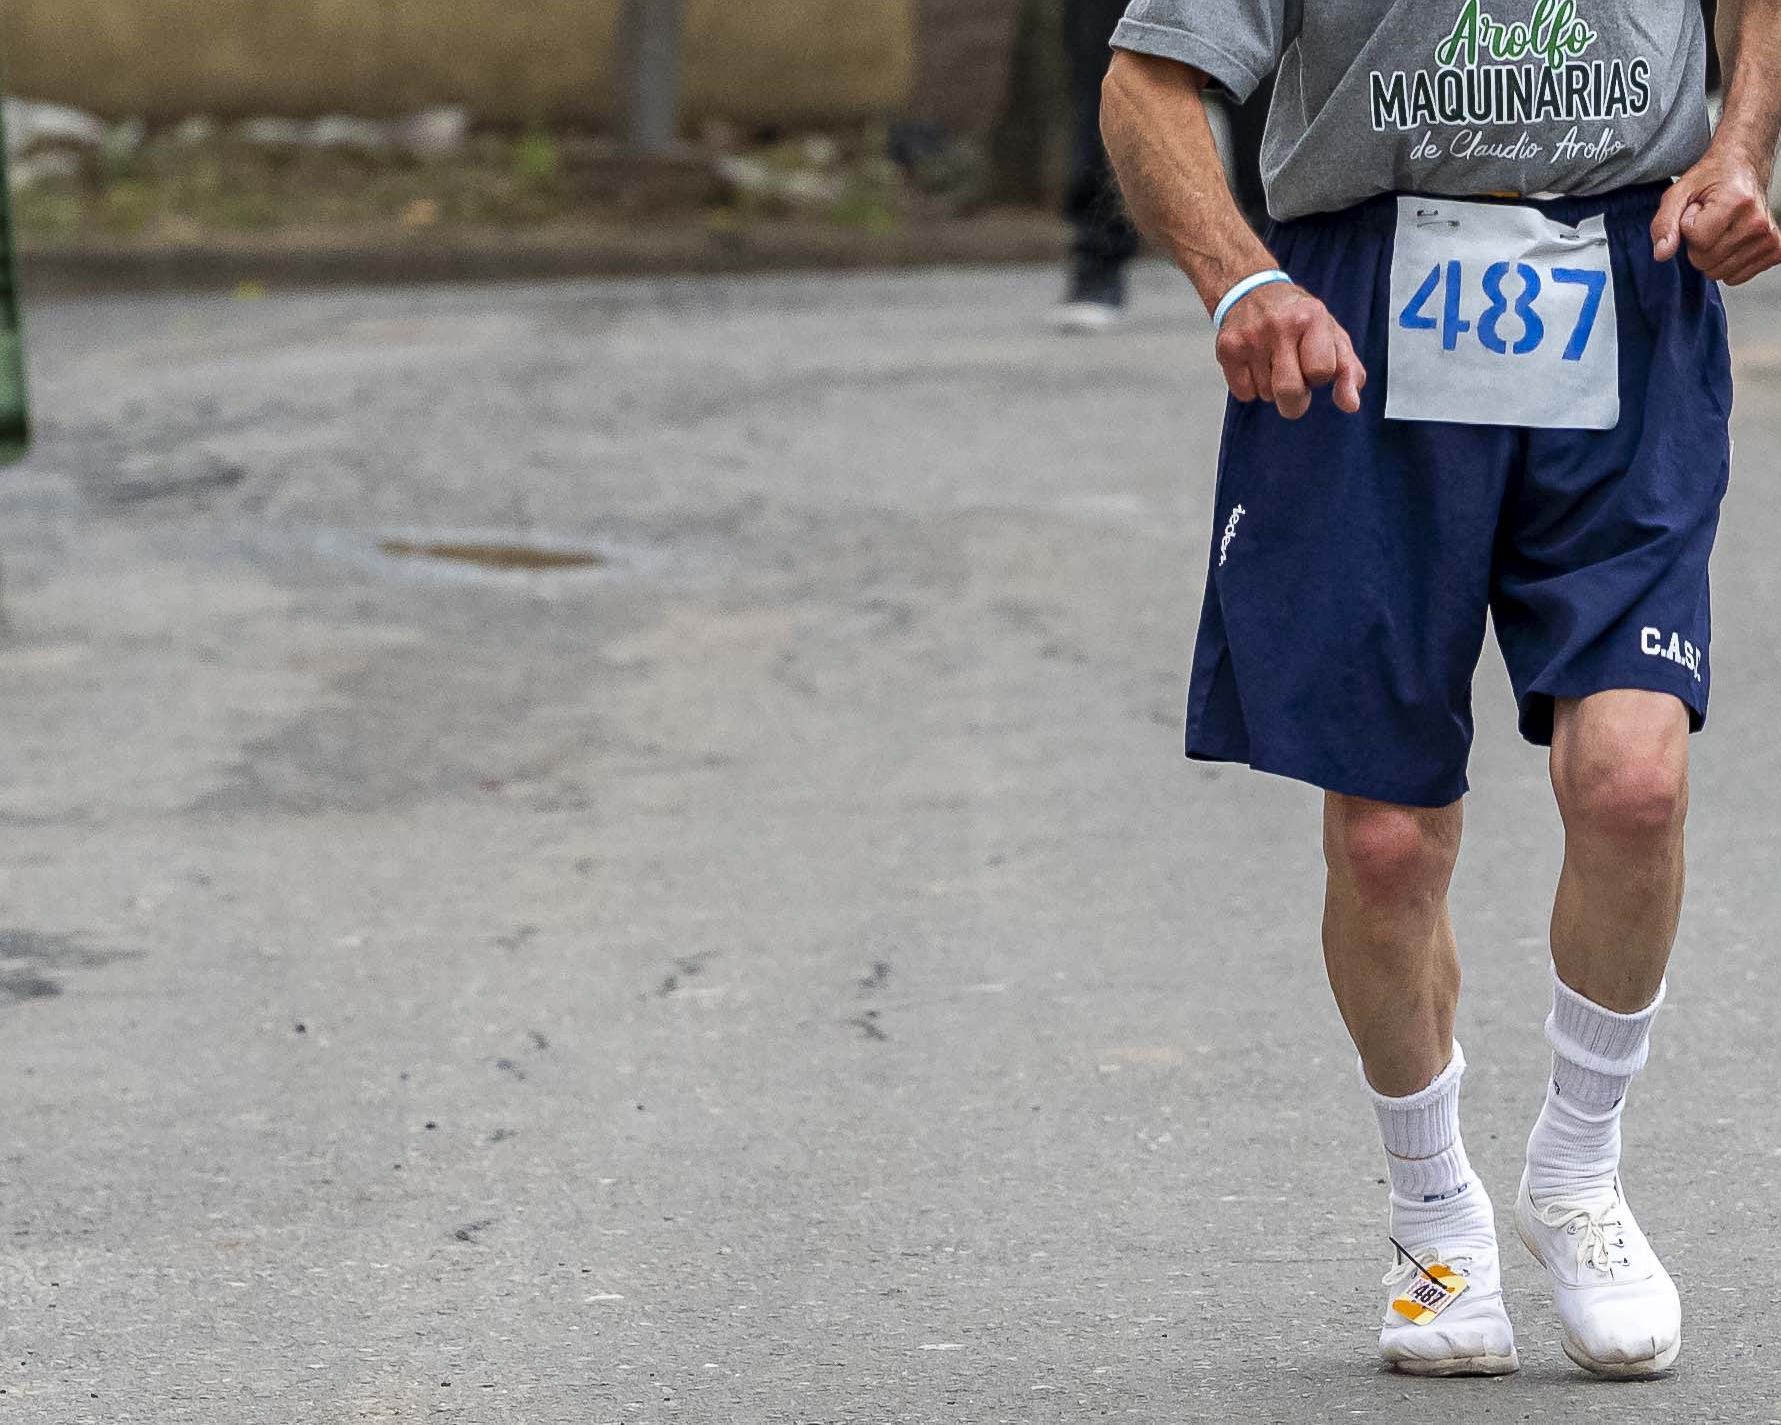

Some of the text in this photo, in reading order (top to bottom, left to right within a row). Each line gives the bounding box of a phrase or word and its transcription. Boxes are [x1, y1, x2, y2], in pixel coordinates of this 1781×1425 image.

[1370, 58, 1650, 130] MAQUINARIAS
[1410, 126, 1624, 163] de Claudio Arolfo
[1399, 260, 1607, 362] 487
[1413, 1284, 1447, 1306] 487
